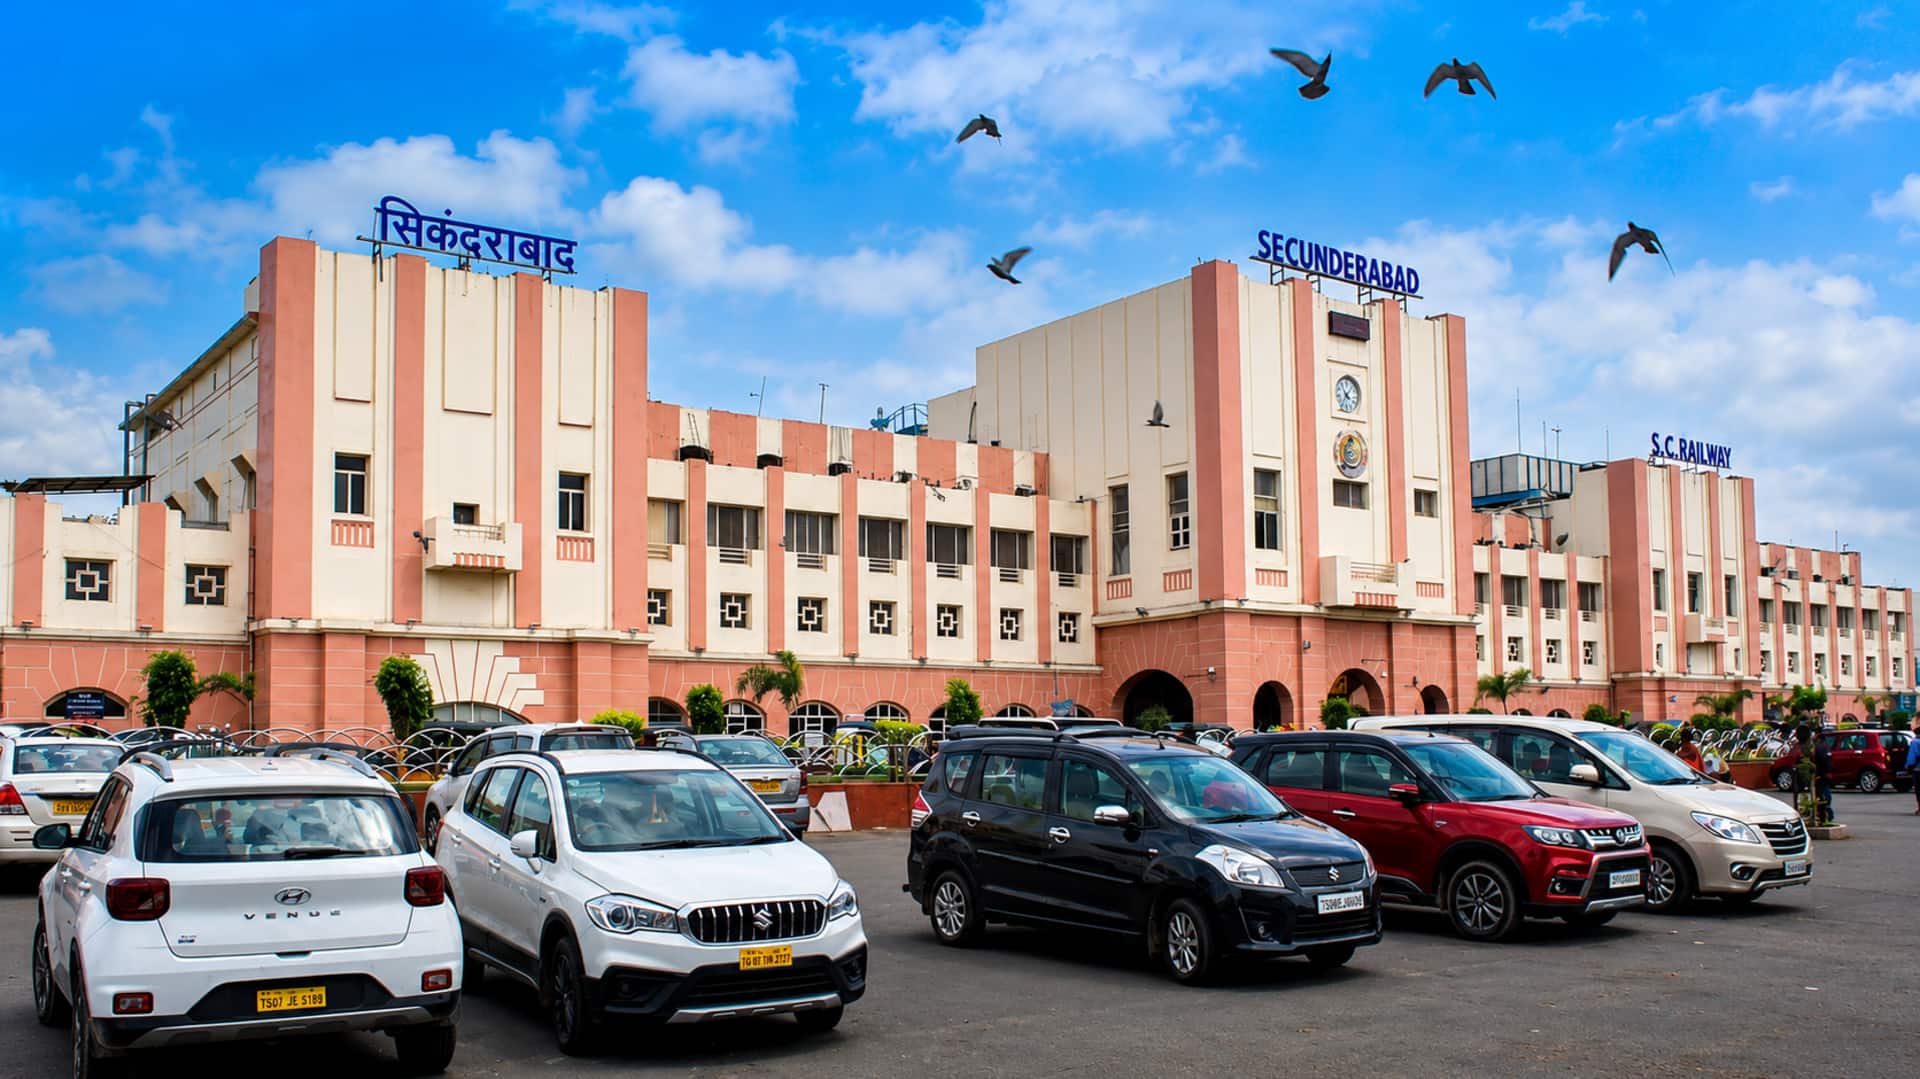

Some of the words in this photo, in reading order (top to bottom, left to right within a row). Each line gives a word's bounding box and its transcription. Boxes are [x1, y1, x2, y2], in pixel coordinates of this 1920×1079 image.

[374, 196, 578, 273] सिकंदराबाद
[1257, 229, 1420, 294] SECUNDERABAD
[243, 909, 342, 921] VENUE
[260, 996, 284, 1009] TS07
[287, 995, 299, 1007] JE
